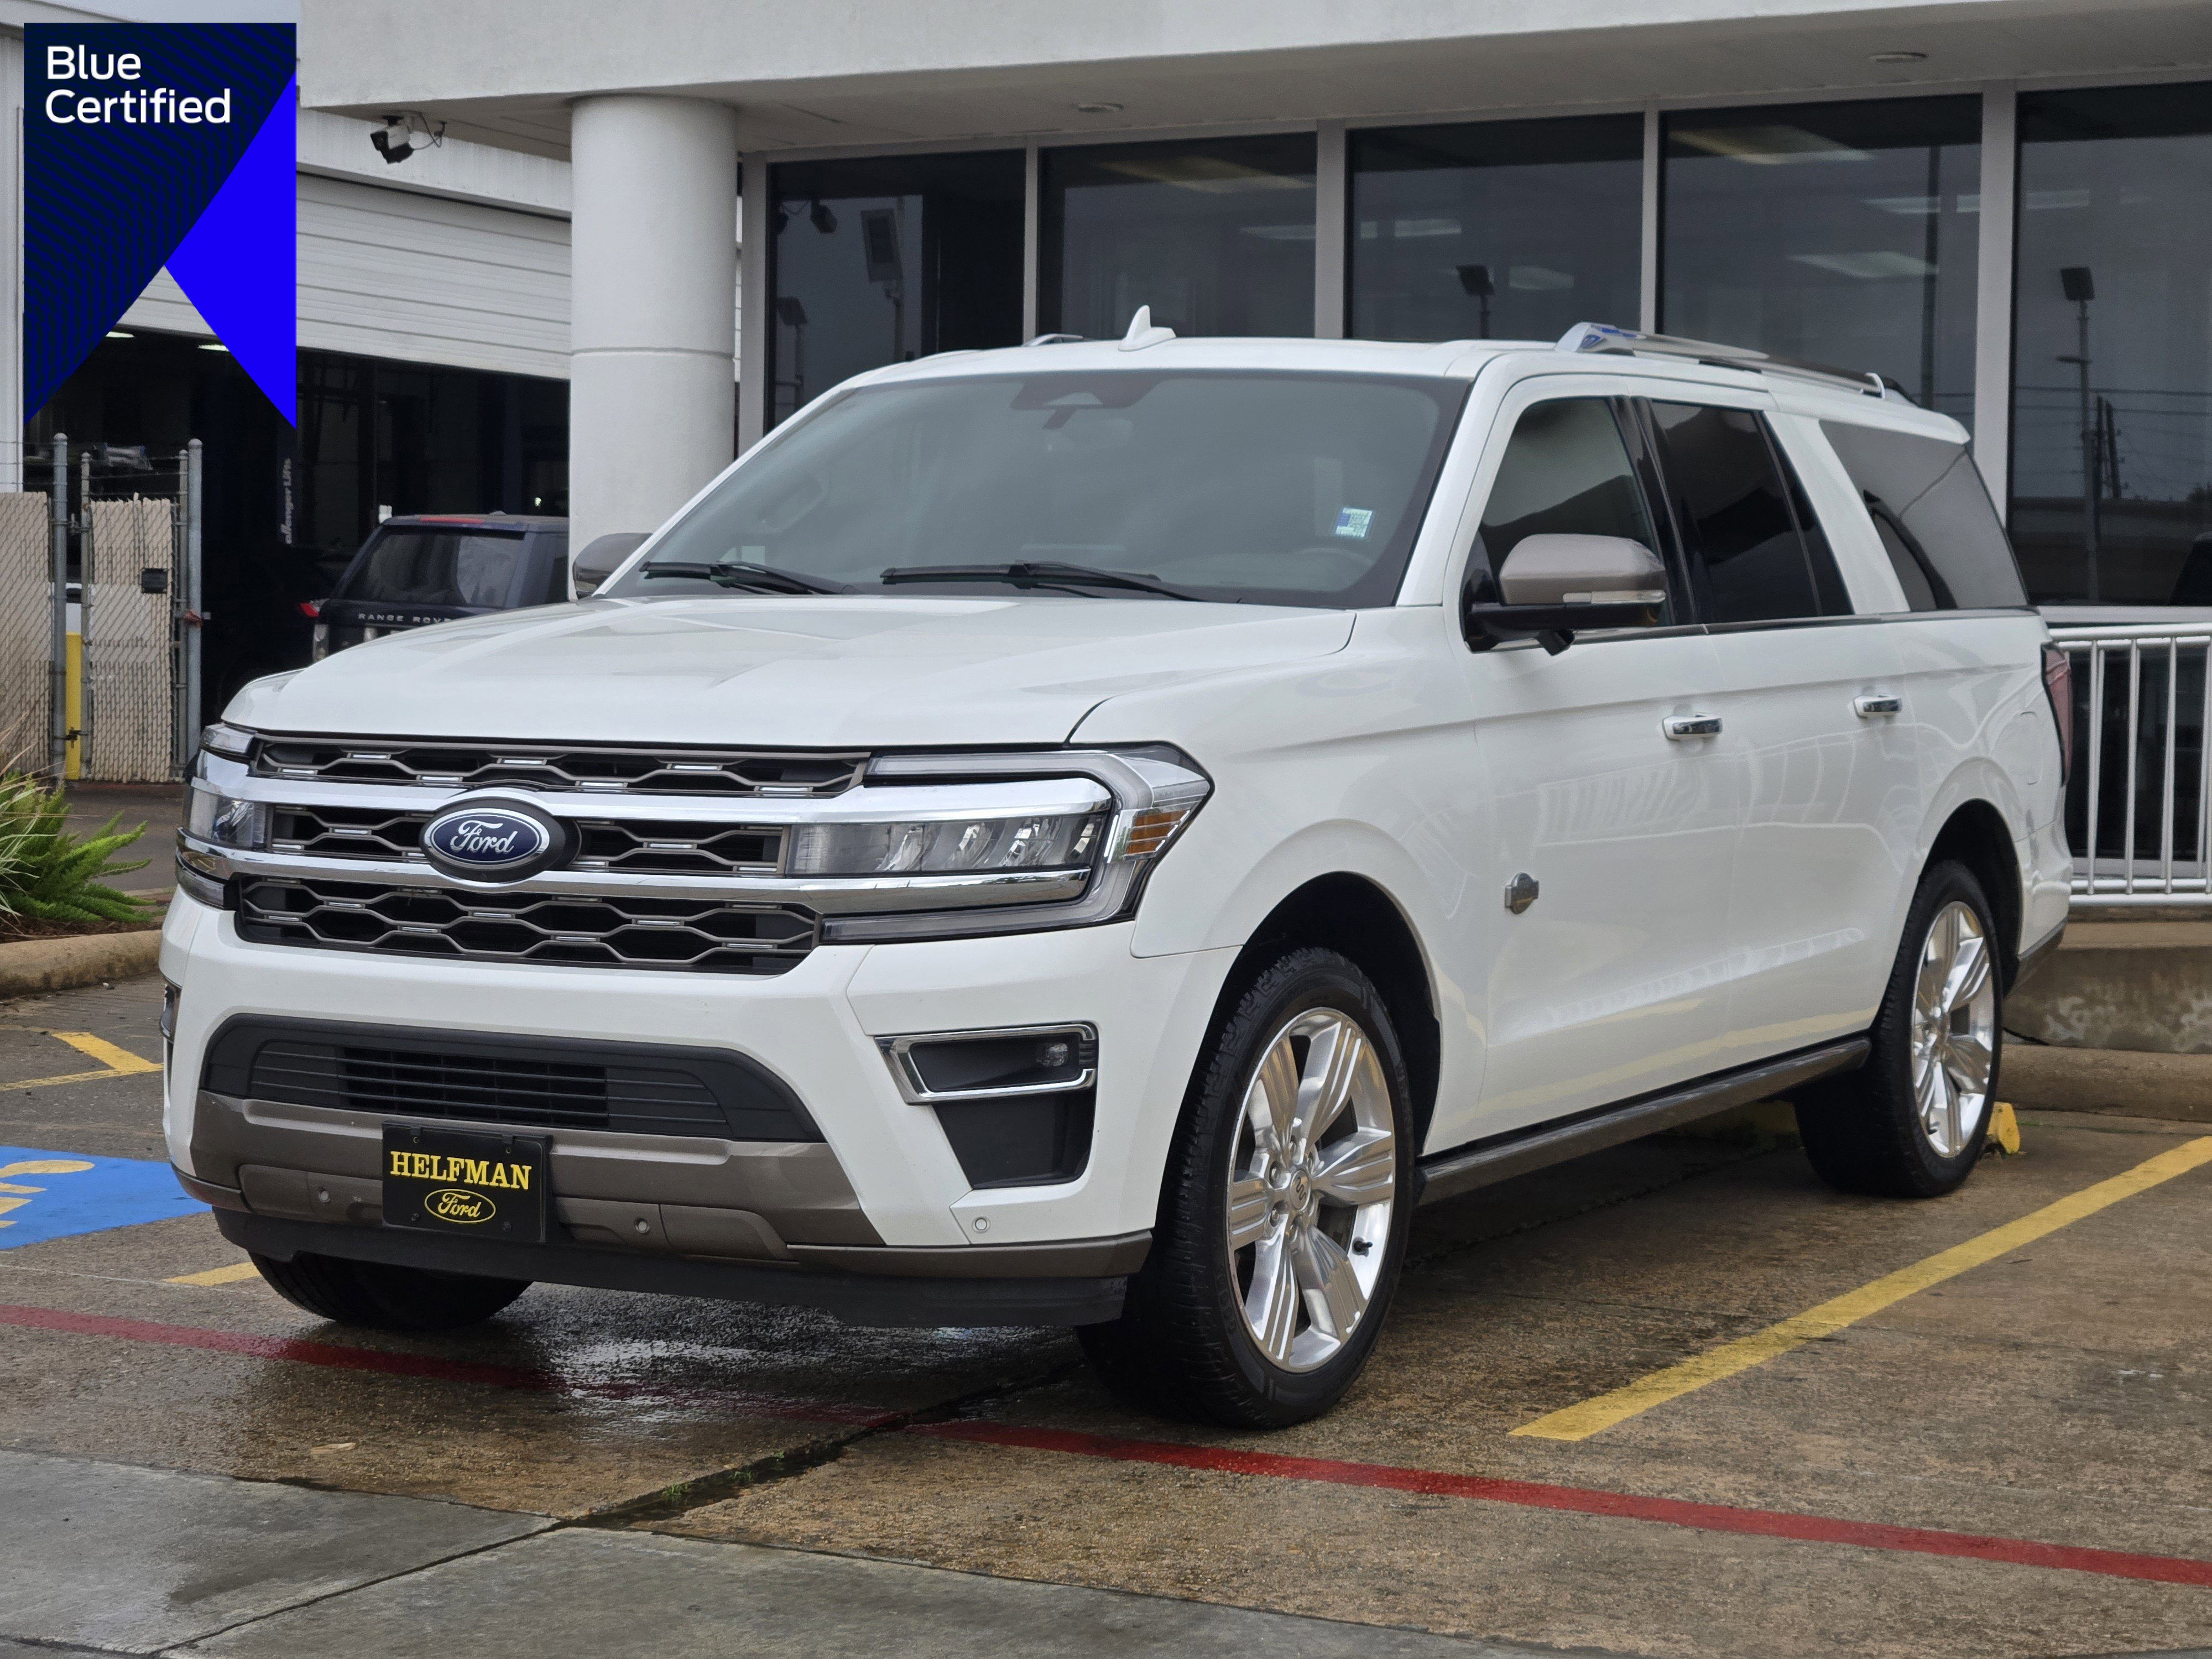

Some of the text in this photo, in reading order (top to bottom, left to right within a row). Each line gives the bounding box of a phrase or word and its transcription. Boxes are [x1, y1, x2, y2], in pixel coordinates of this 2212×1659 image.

[358, 613, 404, 622] RANGE
[450, 820, 518, 854] Ford
[390, 1151, 532, 1190] HELFMAN
[437, 1192, 482, 1218] Ford
